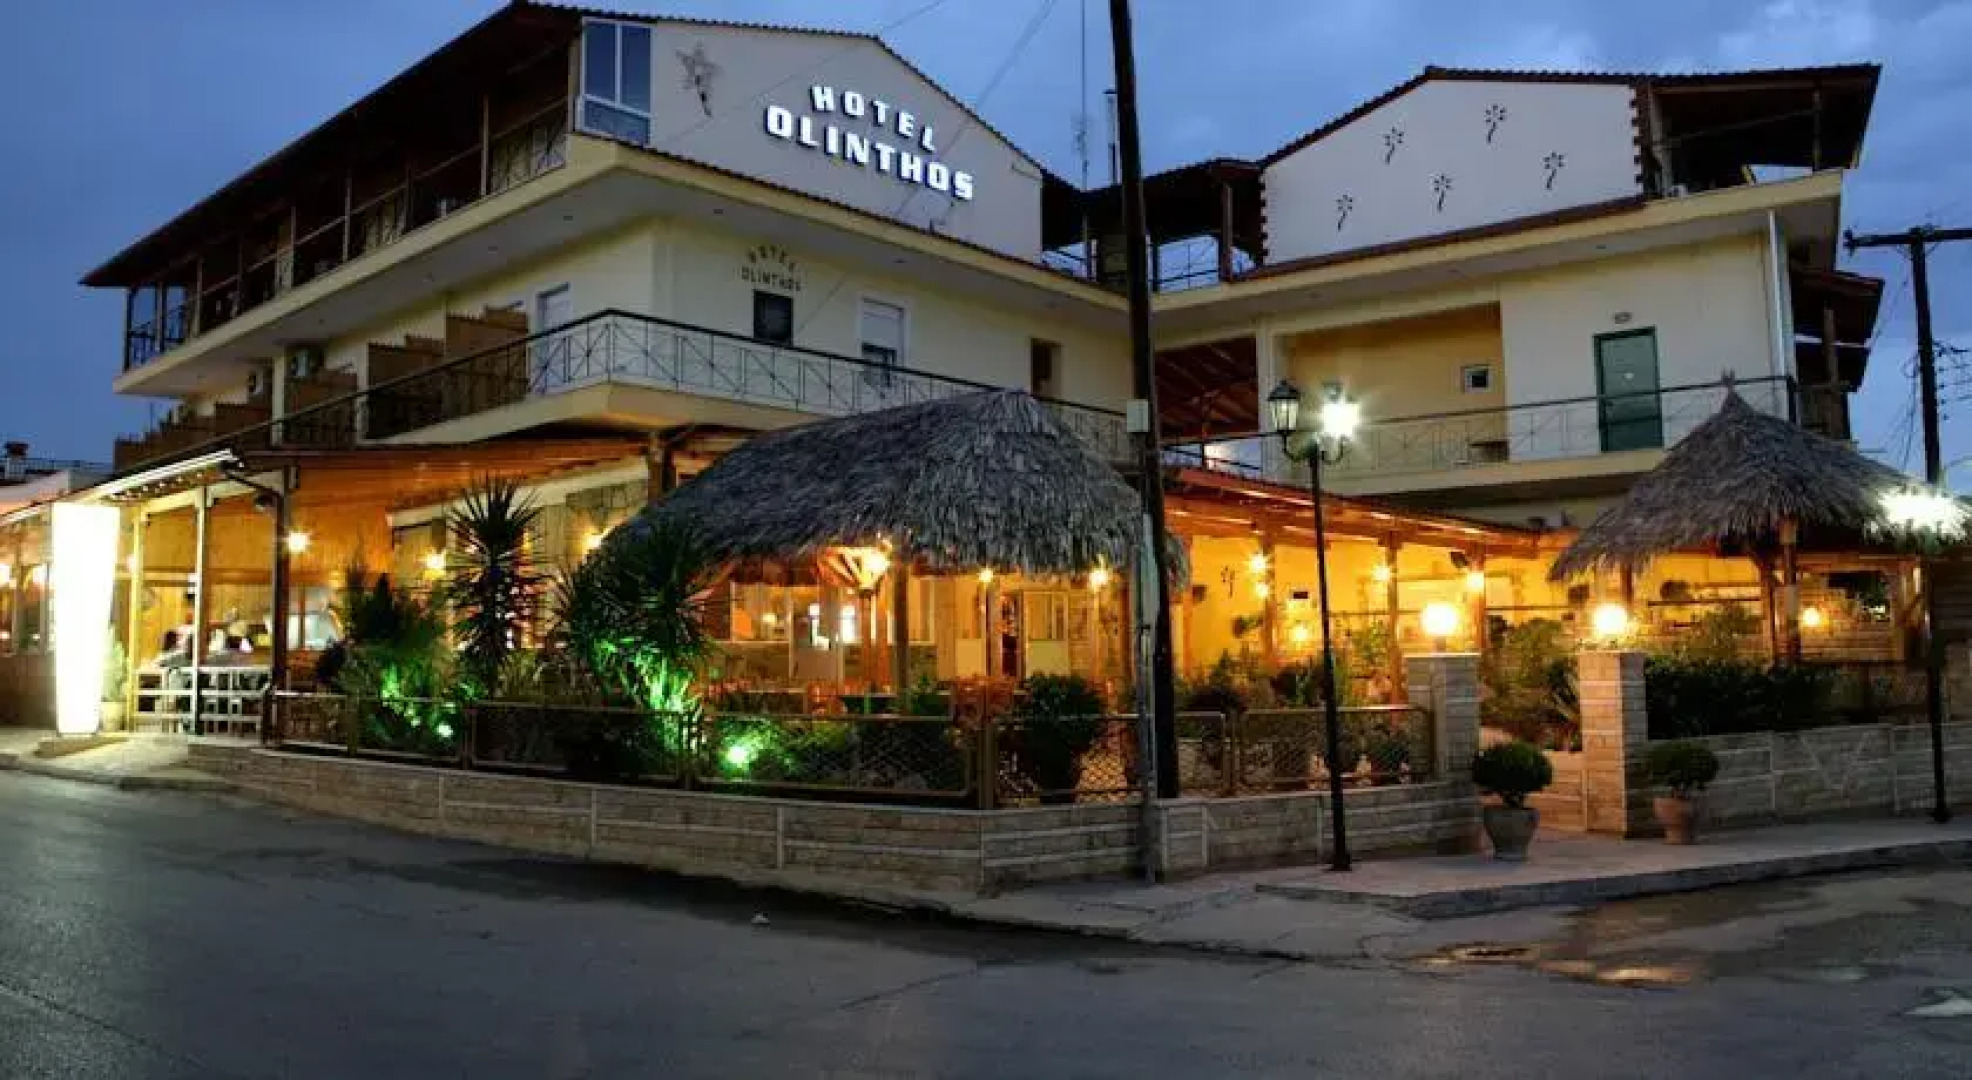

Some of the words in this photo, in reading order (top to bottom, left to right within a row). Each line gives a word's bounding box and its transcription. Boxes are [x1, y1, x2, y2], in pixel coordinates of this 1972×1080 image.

[812, 86, 935, 151] HOTEL
[766, 105, 974, 201] OLINTHOS
[741, 267, 802, 292] OLINTHOS
[747, 245, 796, 272] HOTEL
